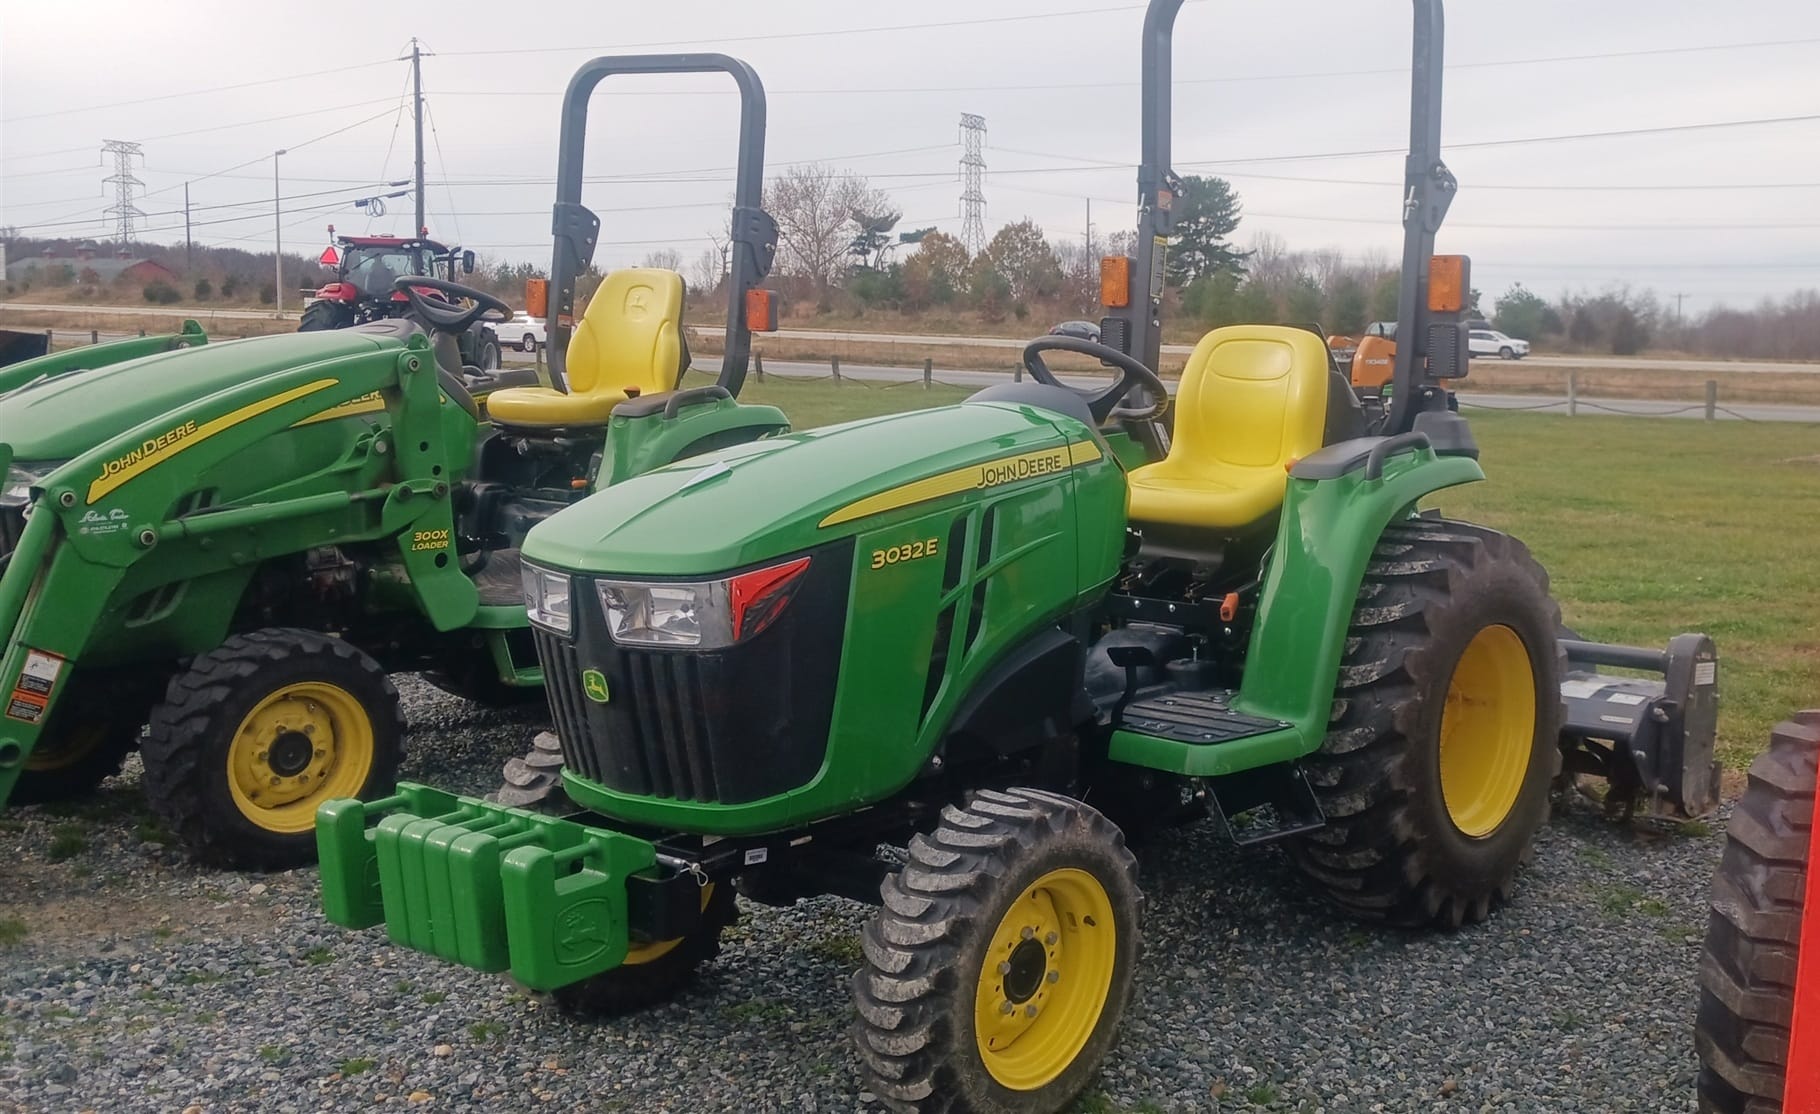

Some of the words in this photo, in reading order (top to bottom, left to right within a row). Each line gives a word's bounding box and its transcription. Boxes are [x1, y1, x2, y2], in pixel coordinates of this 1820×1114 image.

[99, 448, 142, 480] JOHN
[142, 420, 197, 457] DEERE
[977, 463, 1016, 488] JOHN
[1018, 455, 1062, 477] DEERE
[411, 540, 449, 551] LOADER
[414, 529, 449, 541] 300X
